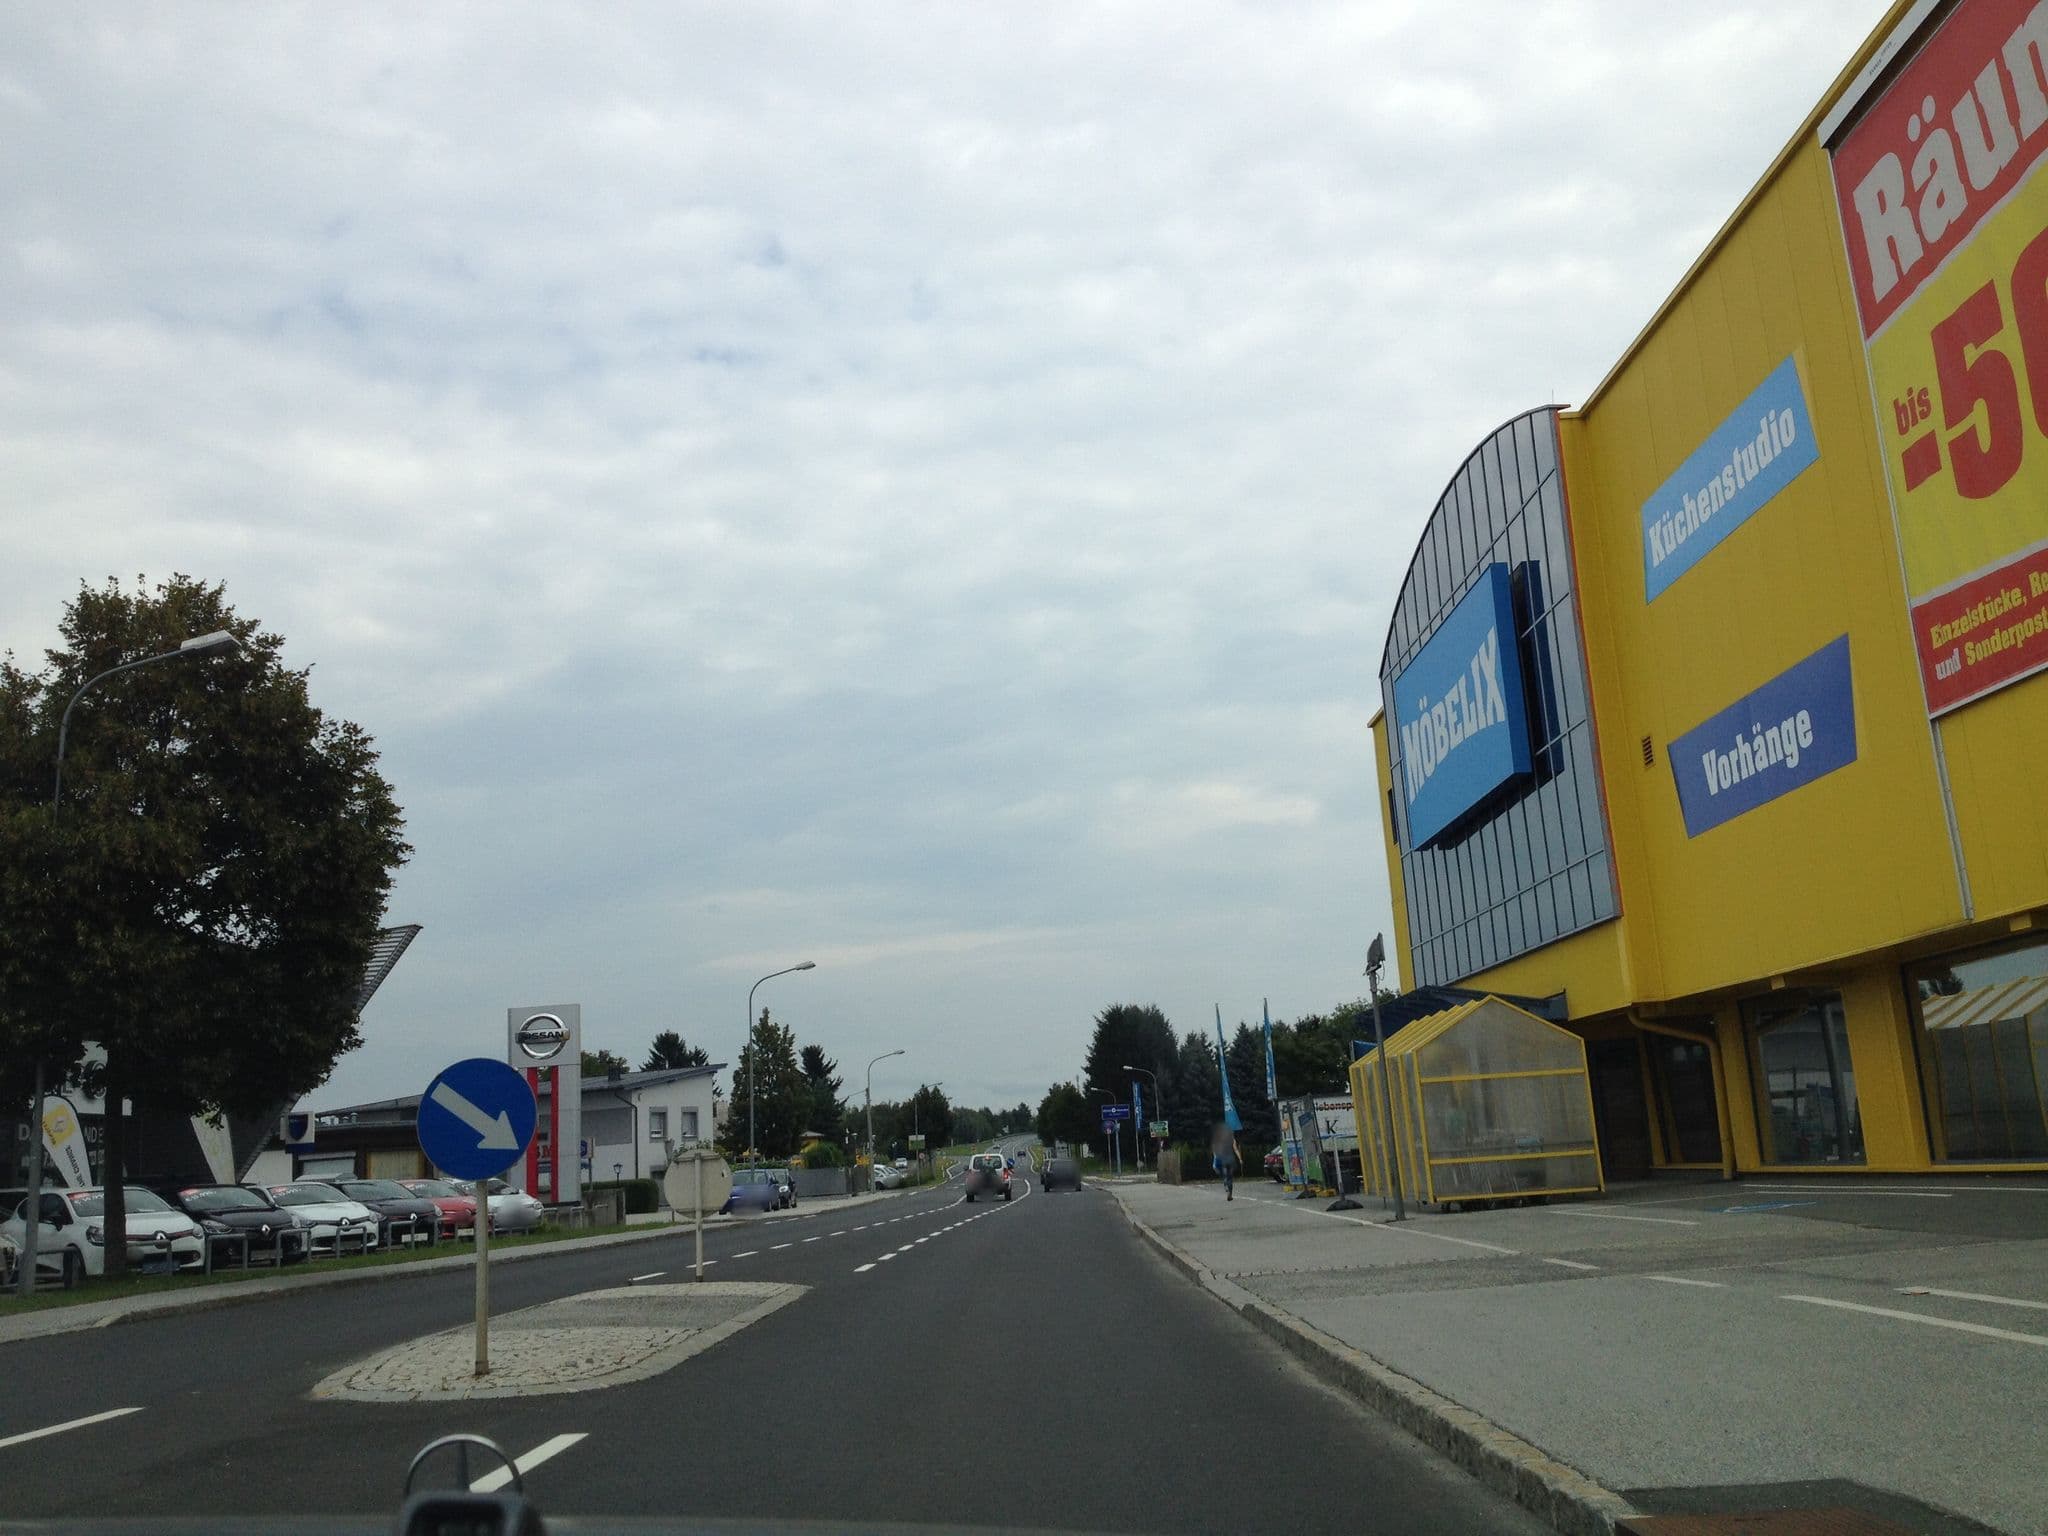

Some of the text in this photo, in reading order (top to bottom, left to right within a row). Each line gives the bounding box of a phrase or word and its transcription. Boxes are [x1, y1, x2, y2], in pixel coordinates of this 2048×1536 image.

[1893, 386, 1932, 436] bis
[1648, 406, 1796, 569] Küchenstudio
[1935, 647, 1962, 681] und
[1402, 625, 1506, 806] MÖBELIX
[1702, 708, 1814, 797] Vorhänge
[1326, 1120, 1338, 1134] K
